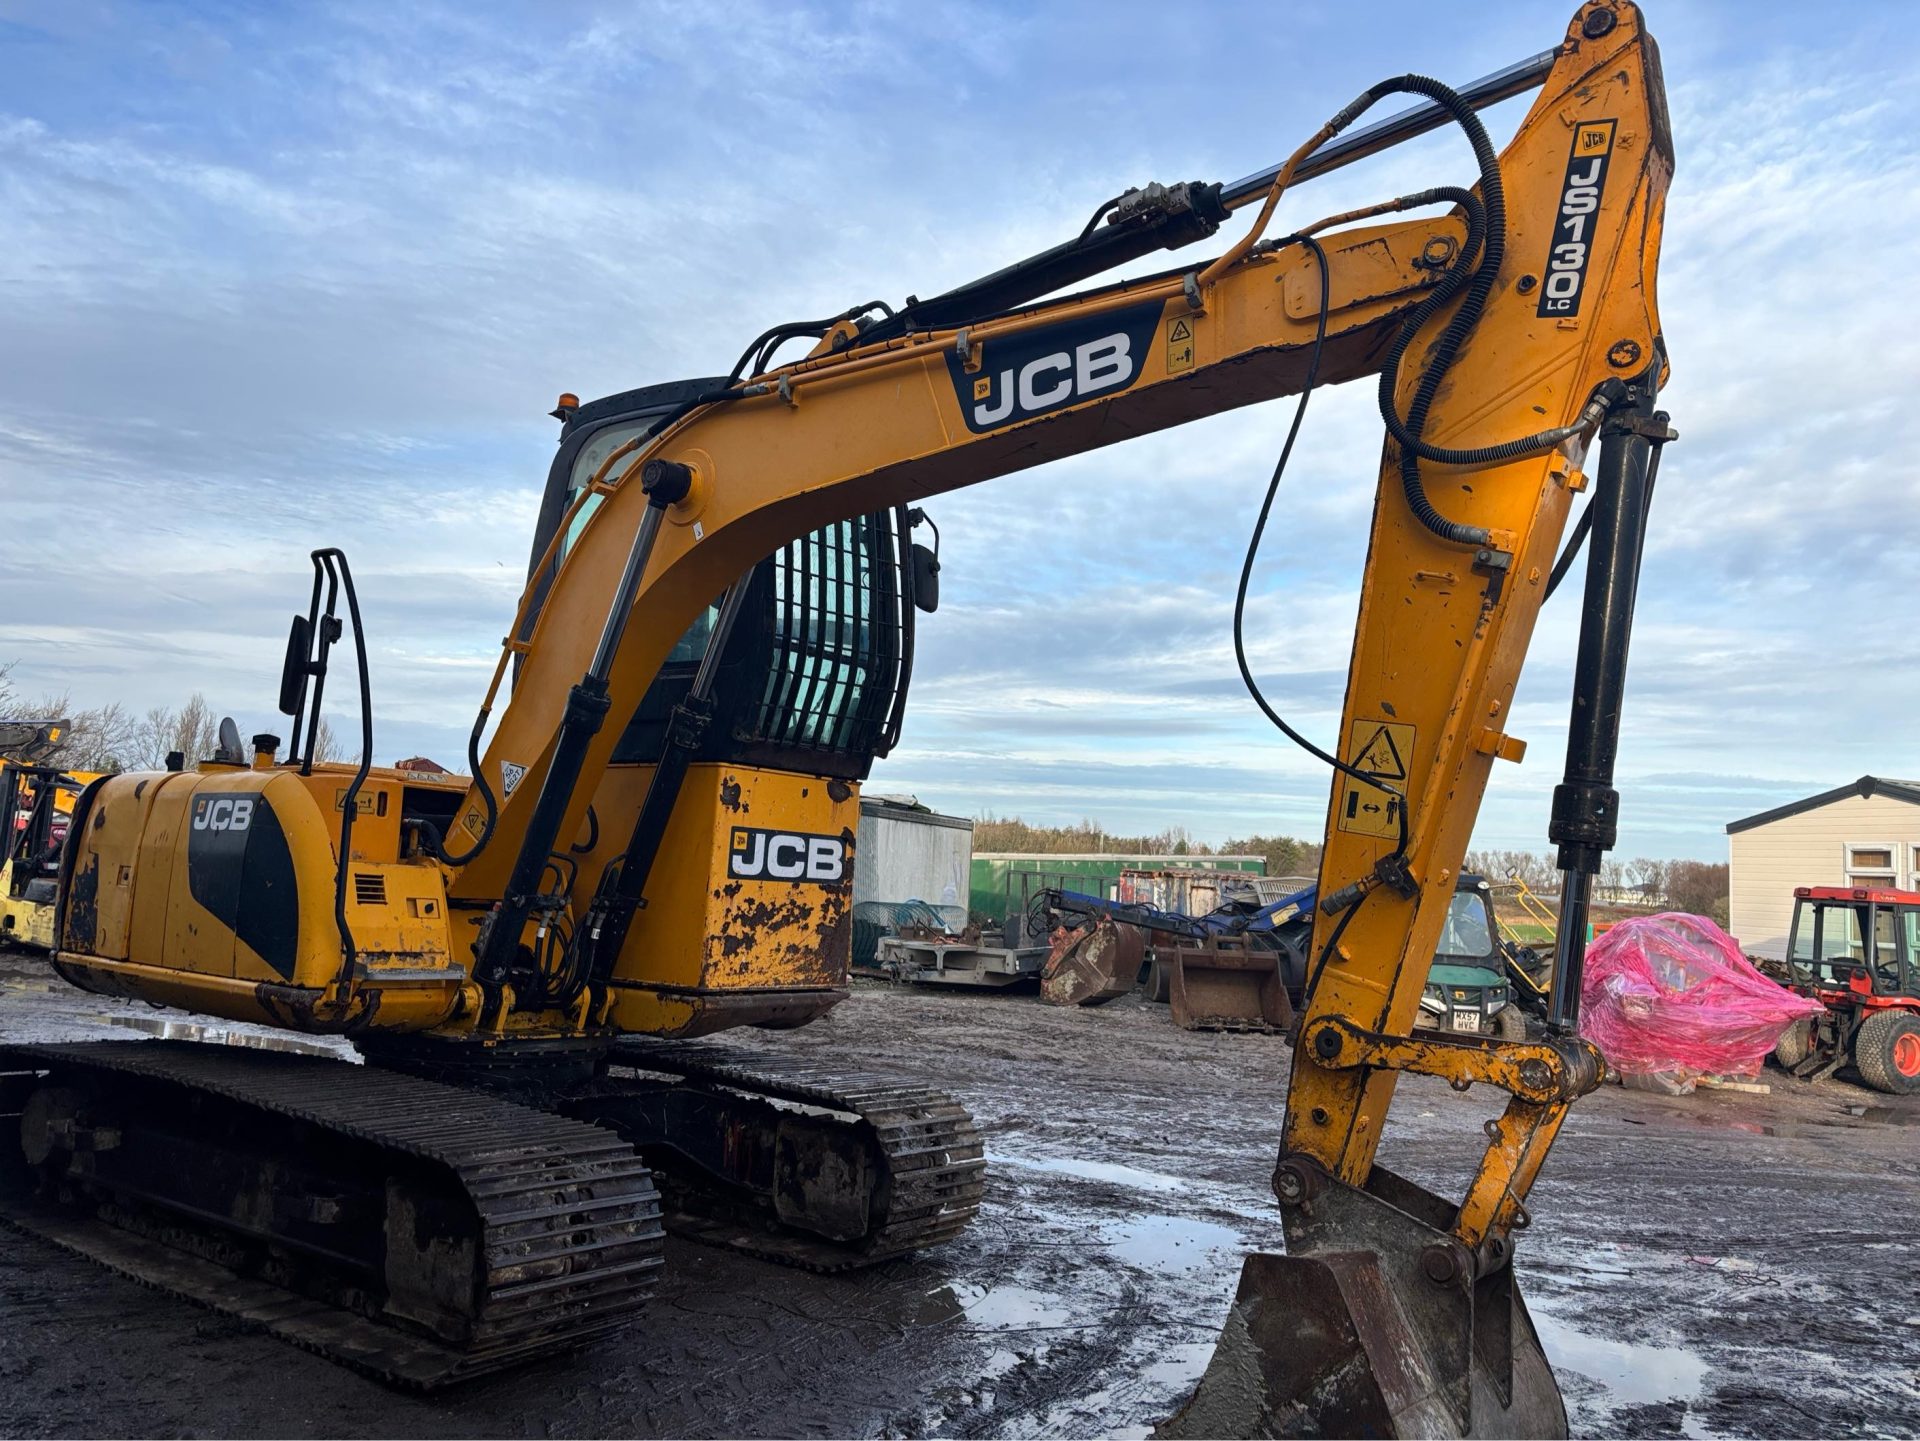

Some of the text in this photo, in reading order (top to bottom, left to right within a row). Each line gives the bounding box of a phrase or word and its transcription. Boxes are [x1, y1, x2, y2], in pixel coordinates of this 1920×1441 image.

[1585, 133, 1604, 148] JCB
[1546, 158, 1602, 298] JS130
[1547, 299, 1571, 310] LC
[974, 332, 1133, 425] JCB
[193, 799, 254, 831] JCB
[731, 833, 843, 880] JCB
